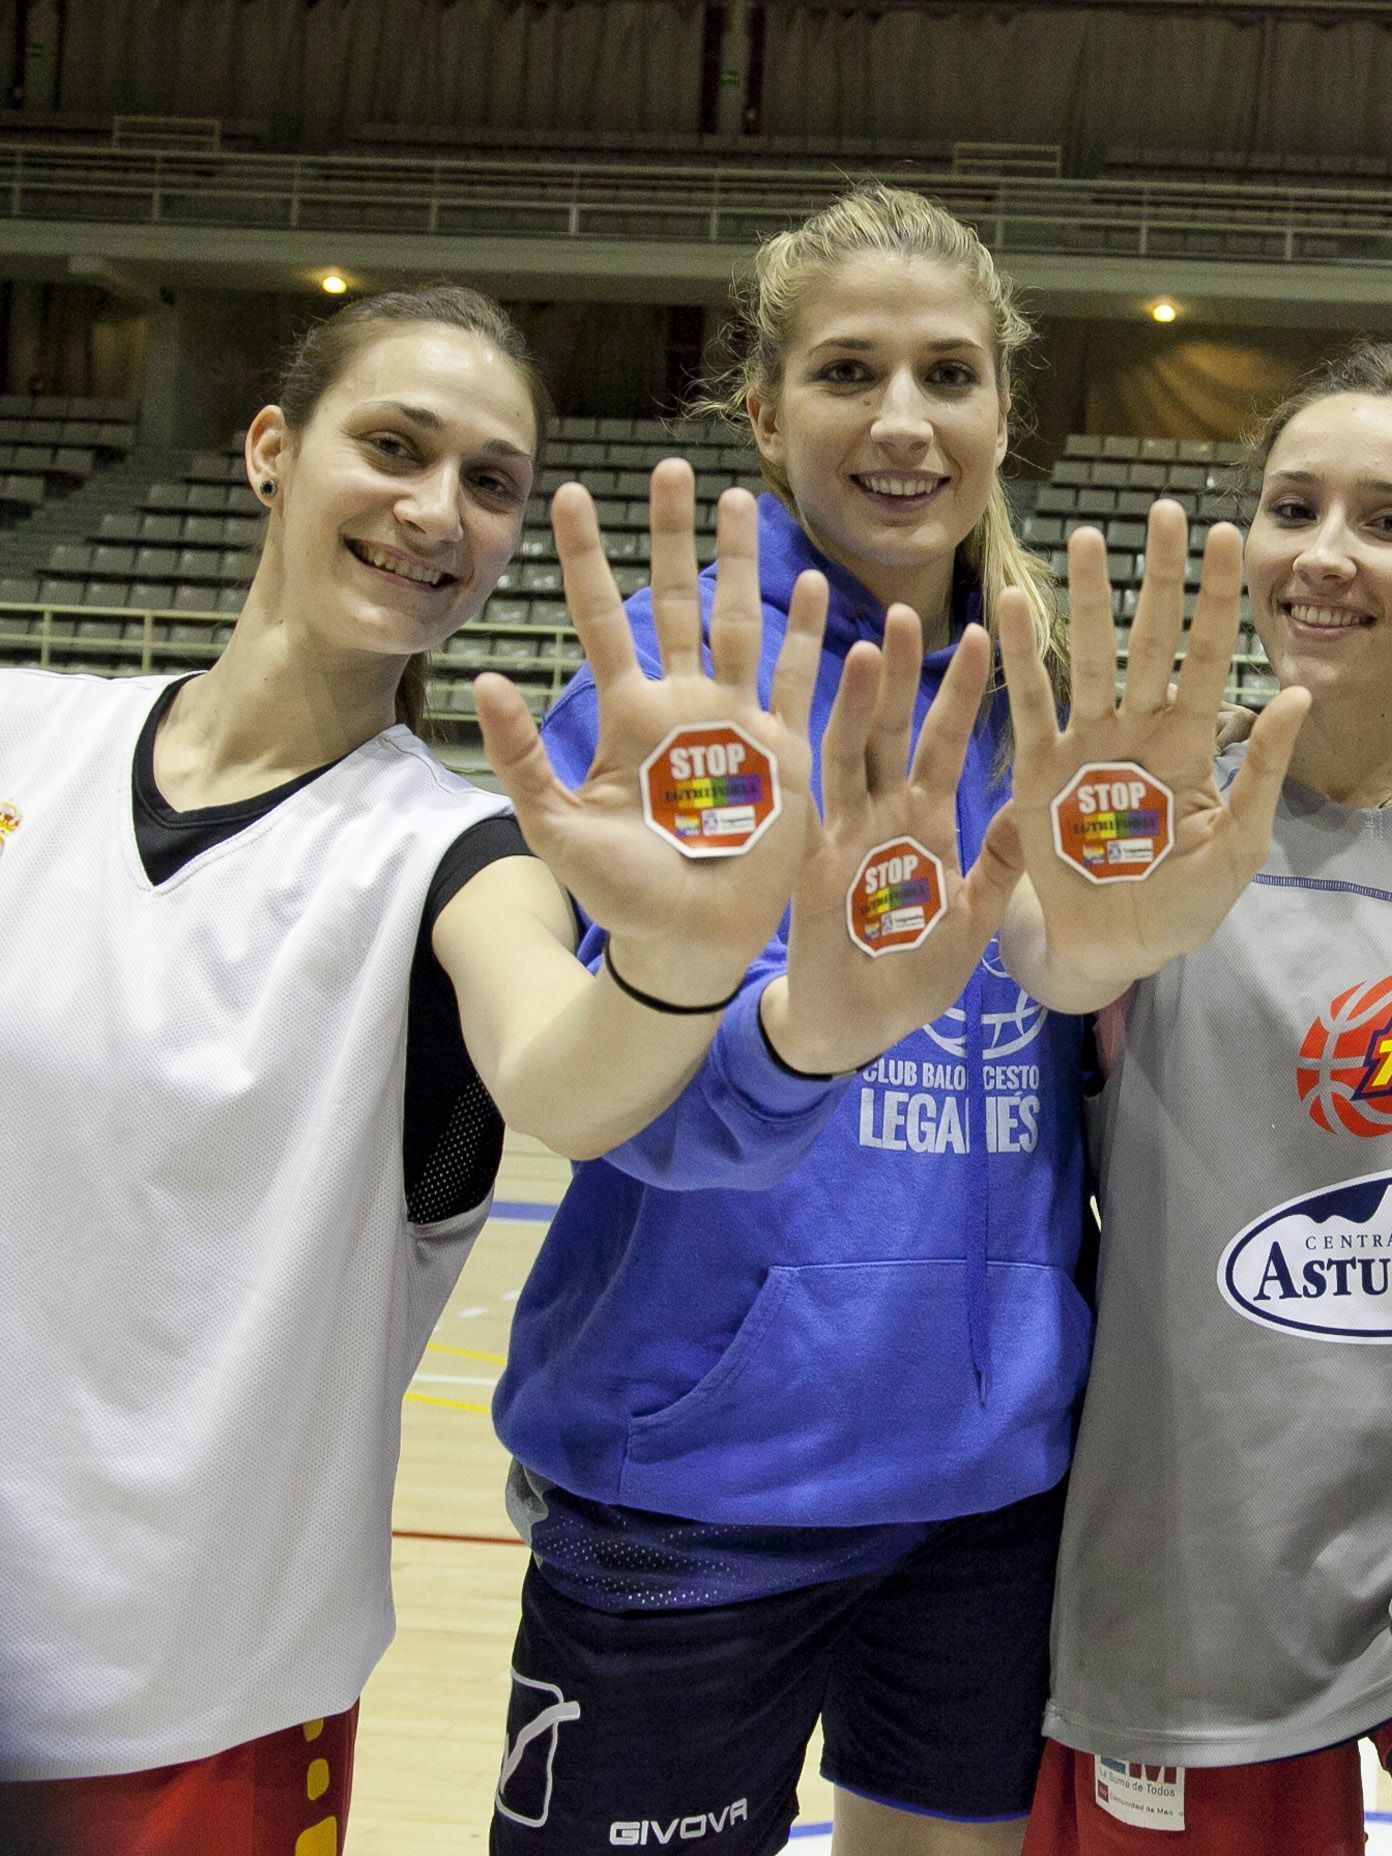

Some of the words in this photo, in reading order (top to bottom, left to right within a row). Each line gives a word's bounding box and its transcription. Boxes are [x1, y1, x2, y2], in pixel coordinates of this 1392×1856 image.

[669, 743, 746, 780] STOP
[1077, 782, 1146, 814] STOP
[865, 855, 918, 894] STOP
[862, 1059, 918, 1087] CLUB
[922, 1062, 1040, 1091] BALOCESTO
[1132, 1780, 1144, 1793] de
[1146, 1782, 1176, 1798] Todos
[609, 1797, 748, 1846] GIVOVA
